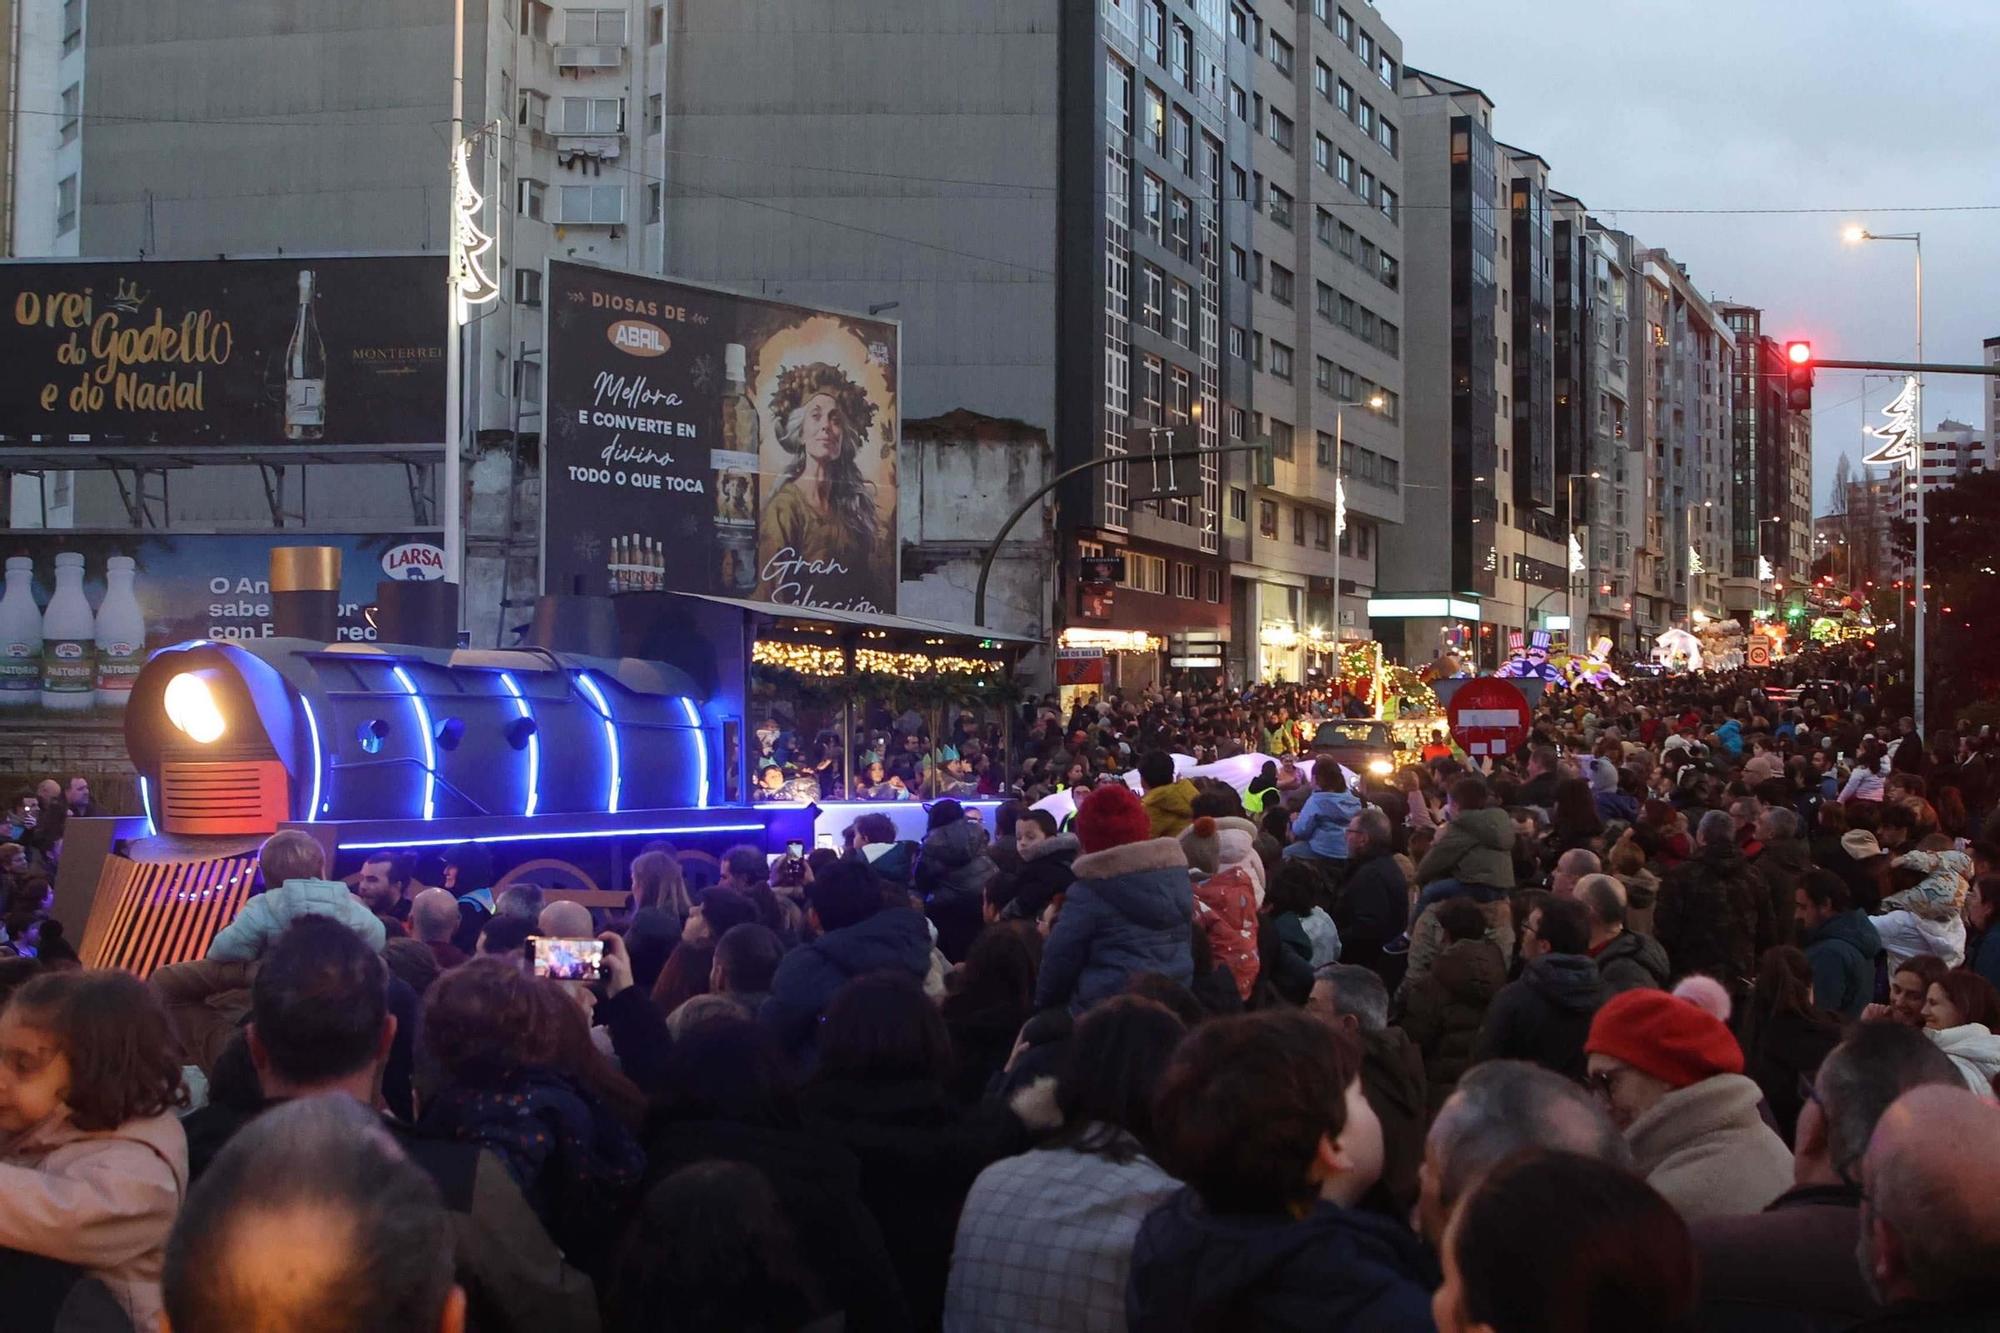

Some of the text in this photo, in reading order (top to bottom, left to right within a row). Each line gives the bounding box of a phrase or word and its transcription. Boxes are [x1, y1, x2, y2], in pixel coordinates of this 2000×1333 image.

[46, 287, 93, 328] rei
[591, 291, 687, 322] DIOSAS DE
[57, 307, 233, 384] do Godello
[615, 324, 666, 352] ABRIL
[352, 346, 443, 361] MONTERREI
[40, 371, 205, 413] e do Nadal
[593, 370, 684, 412] Mellora
[578, 409, 697, 439] E CONVERTE EN
[601, 433, 676, 467] divino
[568, 466, 705, 495] TODO O QUE TOCA
[389, 548, 443, 571] LARSA
[761, 546, 849, 585] Gran
[209, 577, 230, 594] O
[208, 600, 270, 617] sabe
[208, 626, 255, 640] con
